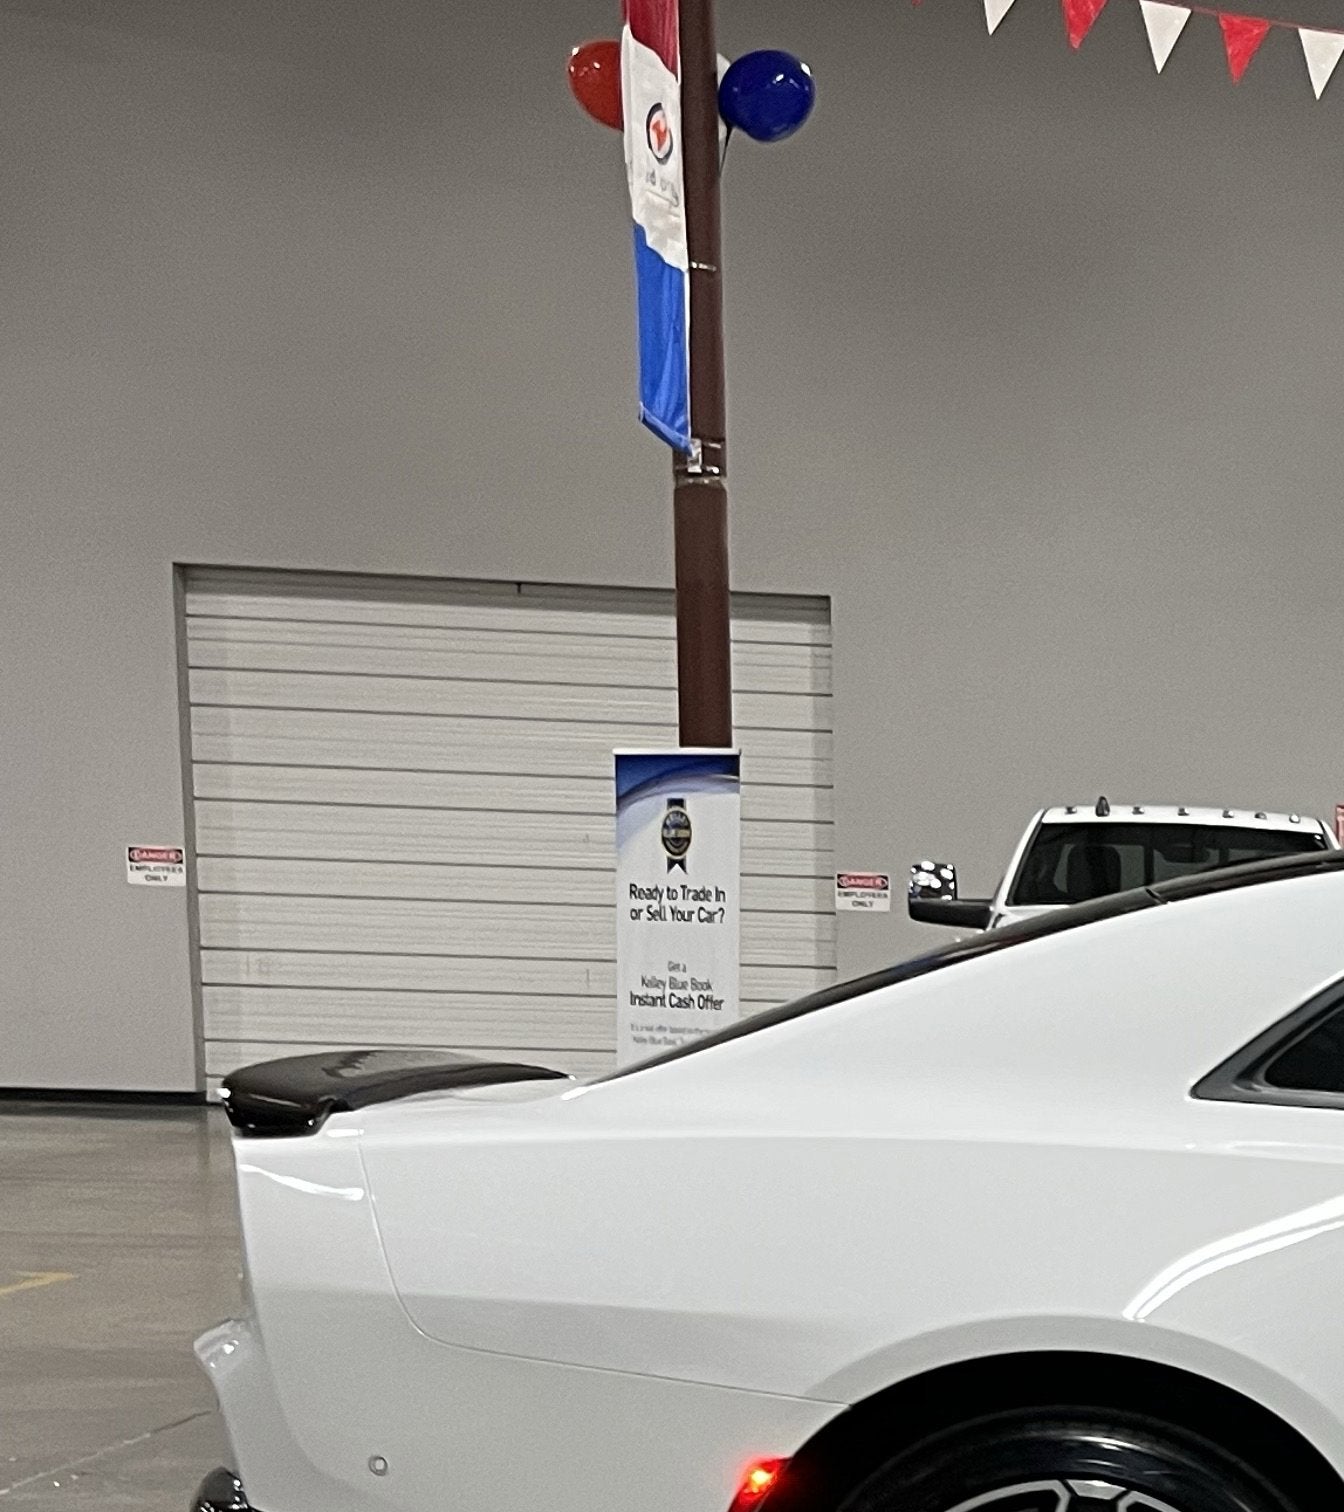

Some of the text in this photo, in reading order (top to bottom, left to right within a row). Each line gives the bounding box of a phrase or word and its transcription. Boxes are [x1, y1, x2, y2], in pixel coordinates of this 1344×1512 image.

[629, 883, 726, 905] Ready to Trade In
[630, 904, 725, 924] or Sell Your Car?
[629, 991, 725, 1011] Instant Cash Offer
